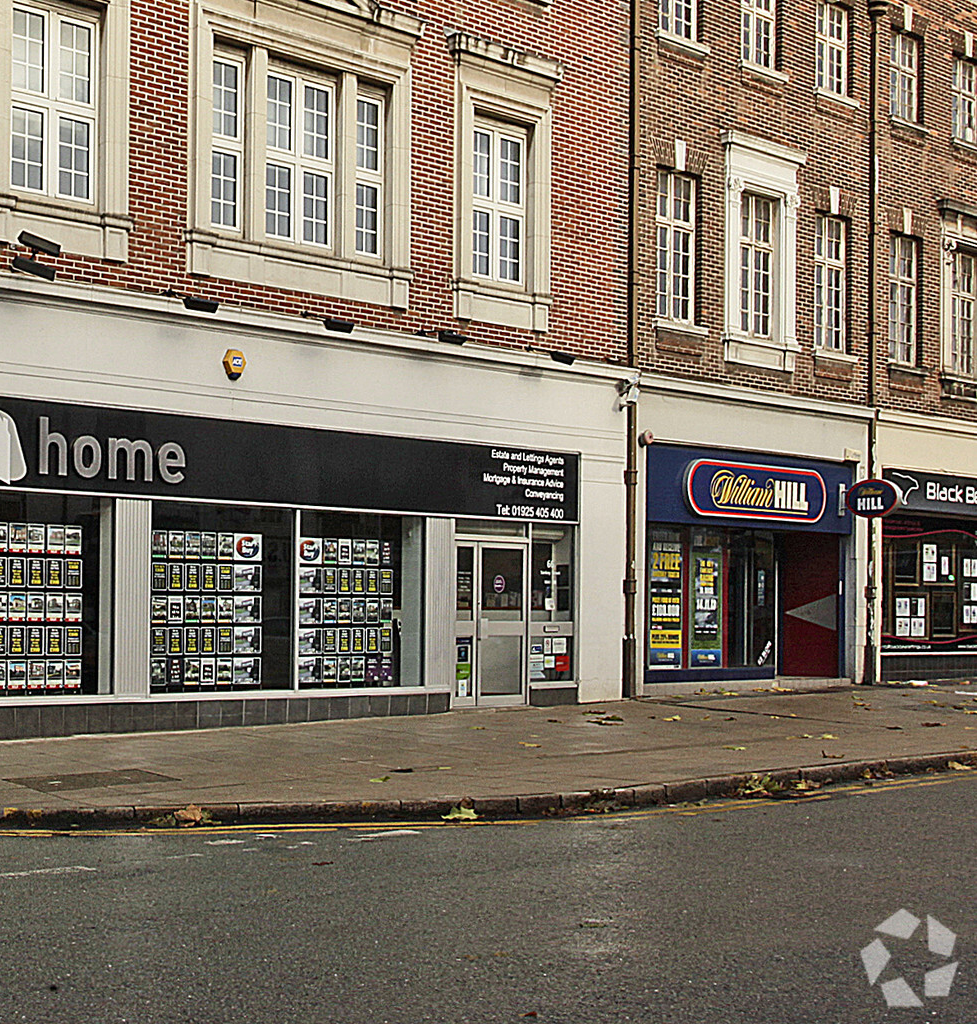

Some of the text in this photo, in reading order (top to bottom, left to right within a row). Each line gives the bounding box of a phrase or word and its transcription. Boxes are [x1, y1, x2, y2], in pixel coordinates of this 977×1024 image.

[39, 416, 186, 484] home
[492, 449, 564, 466] Estate and Lettings Agents
[503, 462, 564, 477] Property Management
[483, 472, 564, 488] Mortgage & Insurance Advice
[525, 488, 564, 502] Conveyancing
[710, 470, 808, 511] William HILL
[926, 482, 977, 504] Black B
[857, 496, 884, 511] HILL
[512, 506, 534, 517] 01925
[536, 507, 549, 518] 405
[550, 508, 564, 519] 400
[661, 553, 680, 570] FREE
